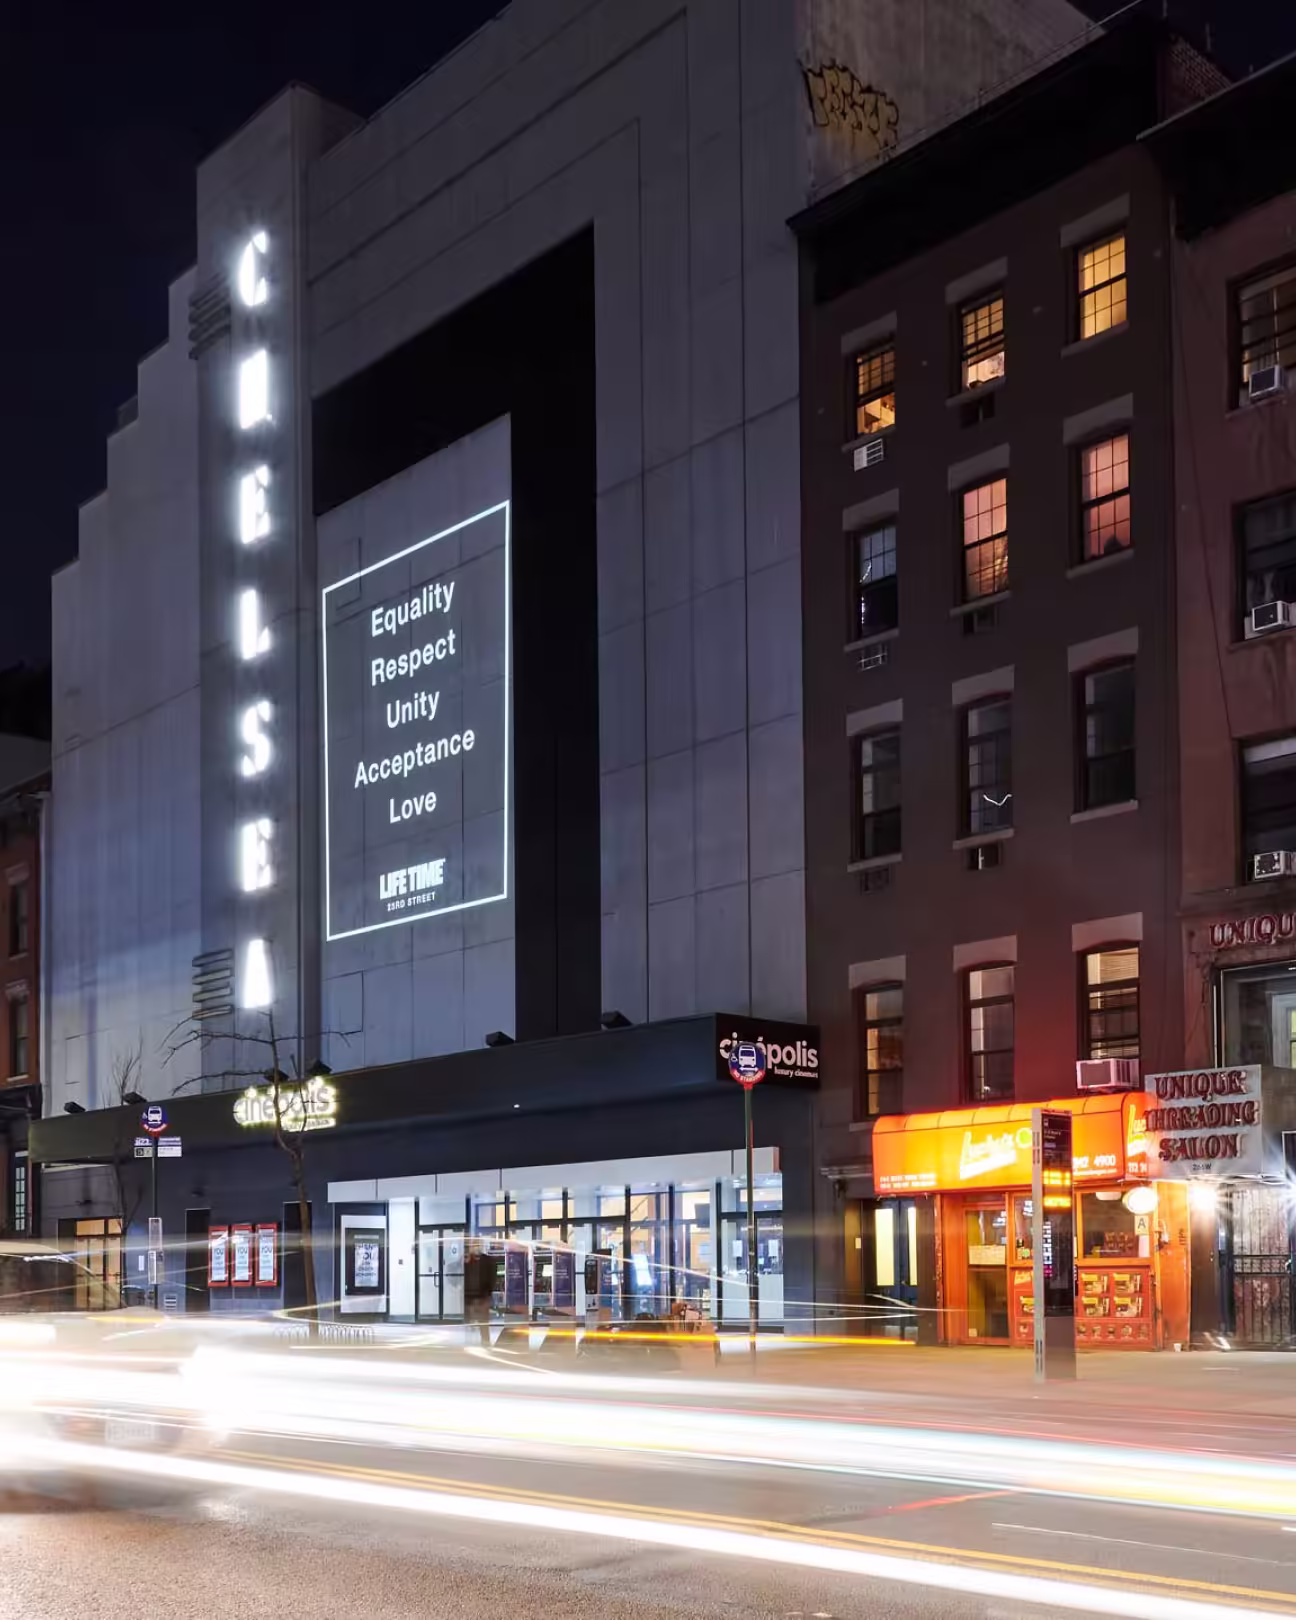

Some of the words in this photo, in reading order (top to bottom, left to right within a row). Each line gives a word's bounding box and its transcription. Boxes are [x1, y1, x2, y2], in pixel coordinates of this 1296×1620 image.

[371, 581, 455, 637] Equality
[371, 629, 456, 686] Respect
[386, 691, 440, 729] Unity
[354, 728, 476, 788] Acceptance
[389, 790, 437, 824] Love
[407, 891, 435, 907] STREET
[719, 1031, 819, 1069] cipolis
[1154, 1069, 1247, 1102] UNIQUE
[1143, 1099, 1259, 1131] THREADING
[1158, 1132, 1242, 1162] SALON
